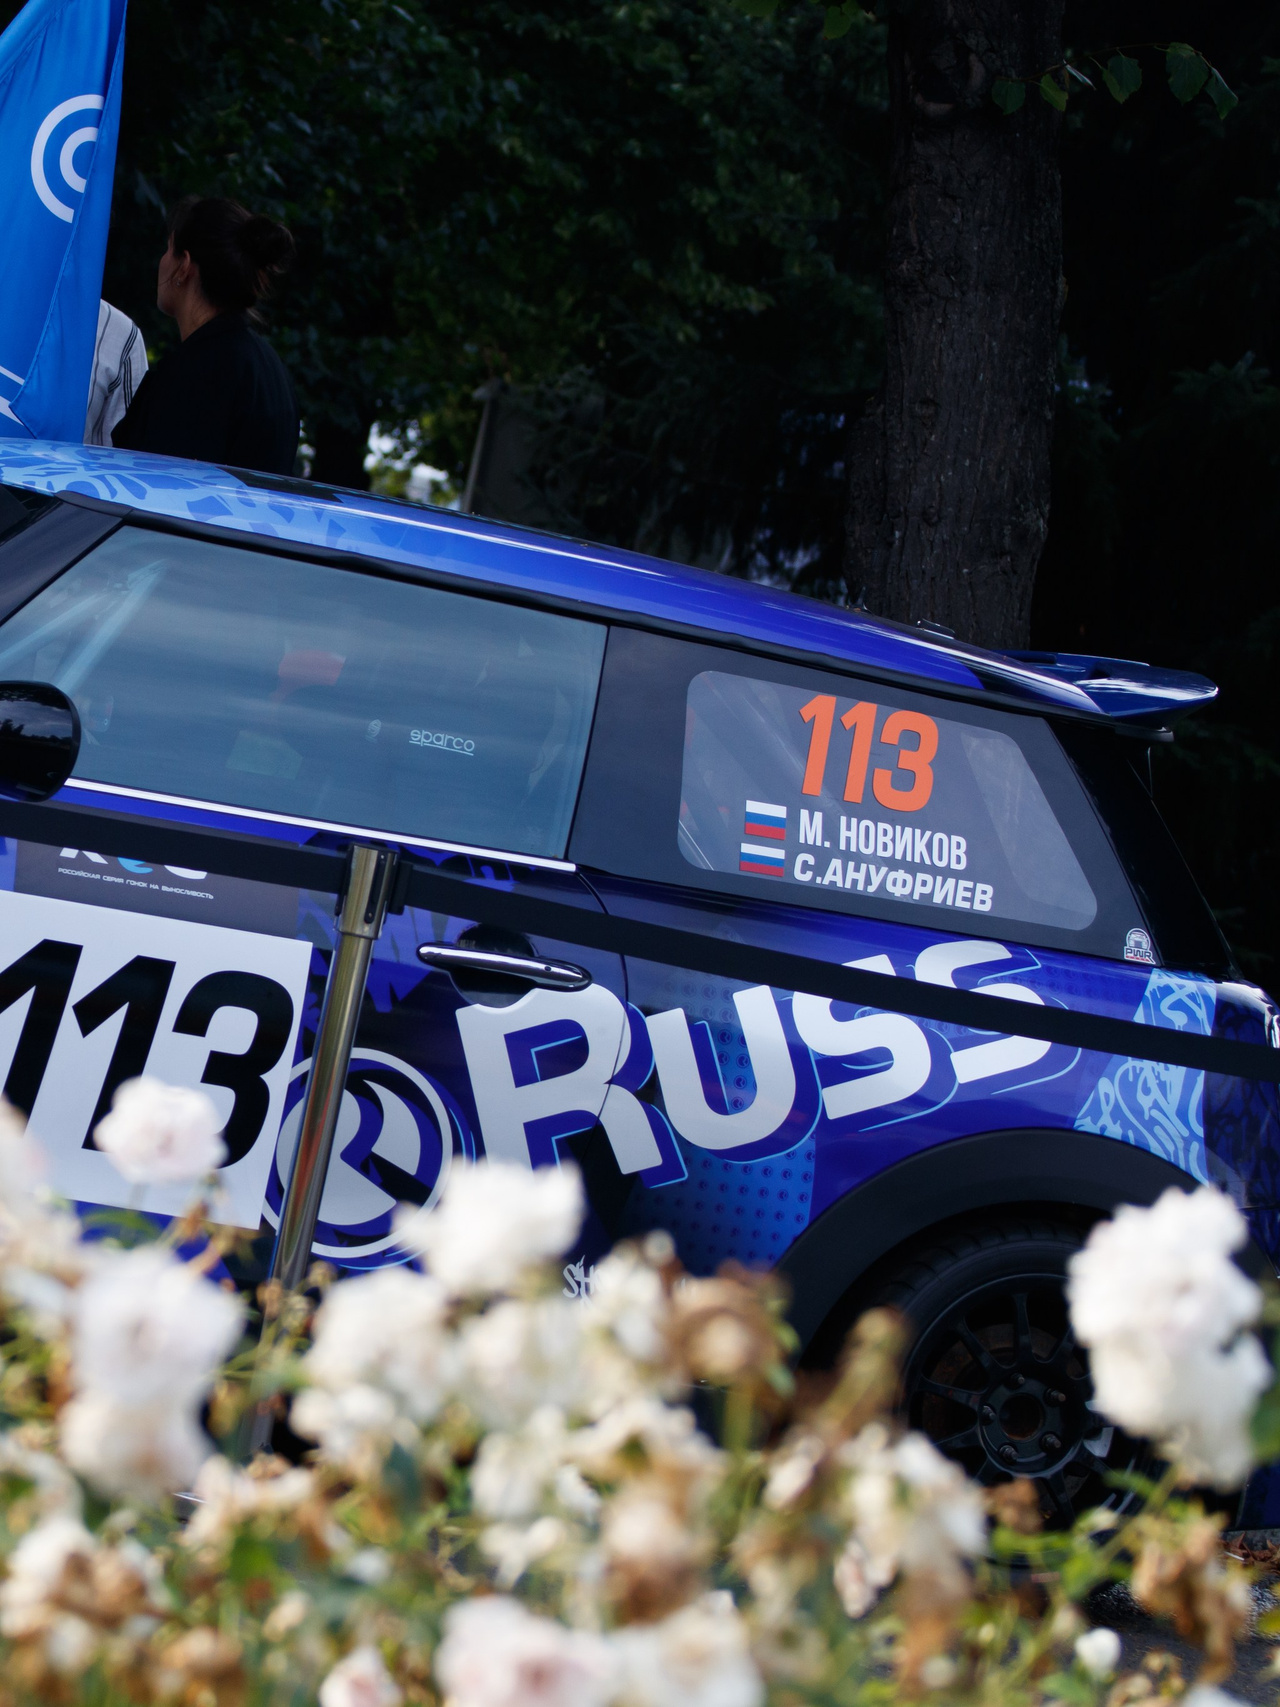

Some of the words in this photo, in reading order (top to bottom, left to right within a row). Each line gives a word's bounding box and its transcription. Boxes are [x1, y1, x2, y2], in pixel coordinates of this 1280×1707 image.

[410, 729, 475, 753] sparco
[798, 694, 939, 812] 113
[798, 807, 831, 849] М.
[838, 814, 968, 871] НОВИКОВ
[57, 867, 101, 881] РОССИЙСКАЯ
[102, 875, 125, 884] СЕРИЯ
[126, 879, 148, 889] ГОНОК
[149, 883, 160, 891] НА
[161, 885, 215, 900] ВЫНОСЛИВОСТЬ
[792, 851, 995, 913] С.АНУФРИЕВ
[1125, 947, 1155, 965] PWR
[455, 940, 1053, 1176] RUSS
